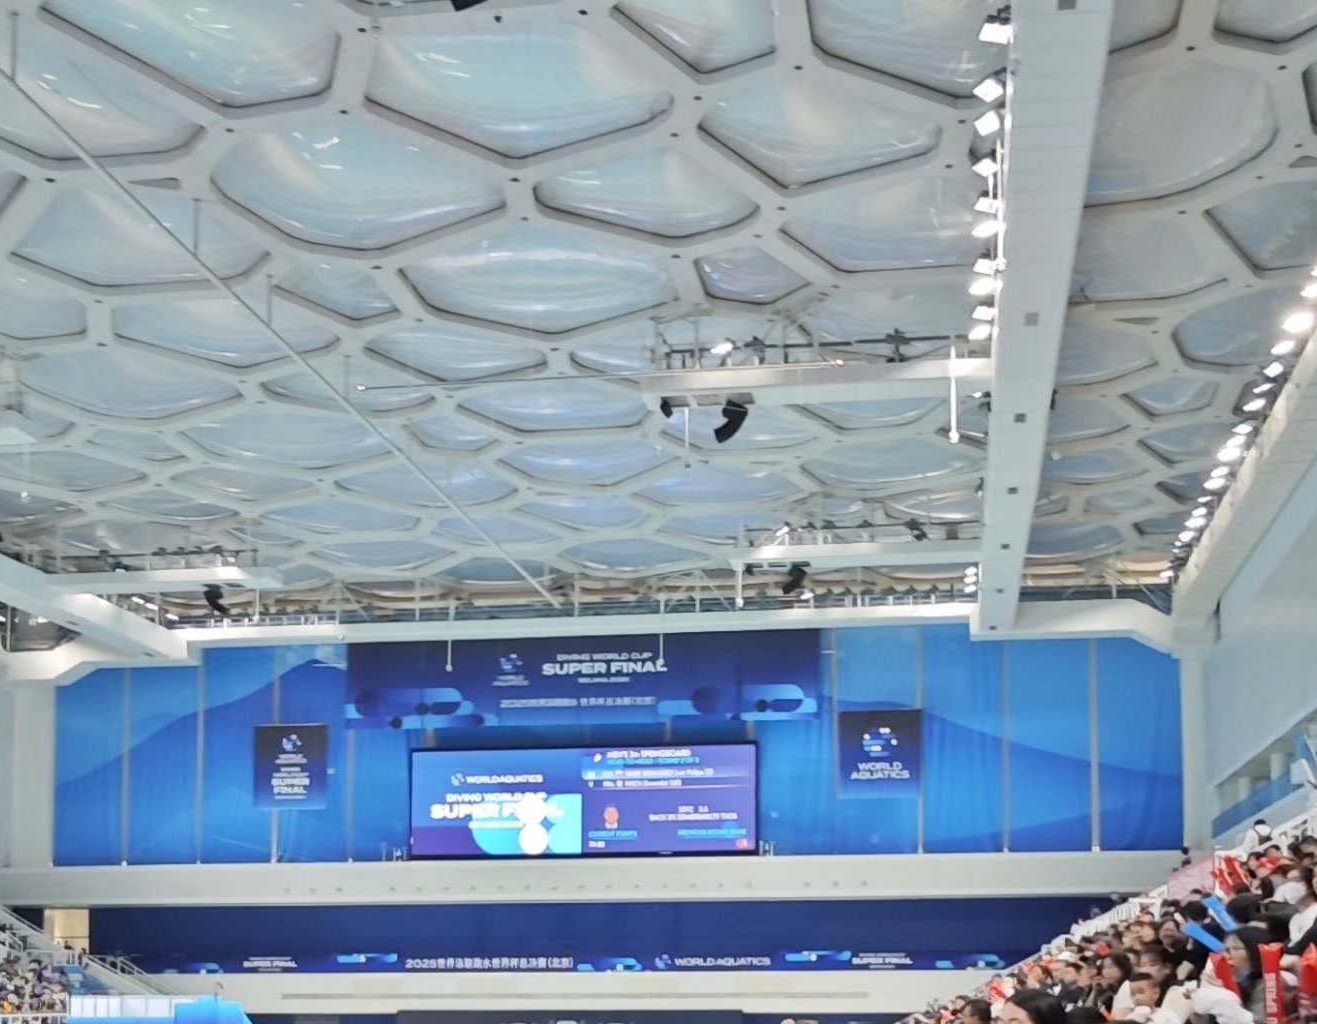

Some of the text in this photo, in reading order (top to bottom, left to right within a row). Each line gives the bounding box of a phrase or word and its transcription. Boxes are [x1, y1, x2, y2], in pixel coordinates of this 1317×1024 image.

[542, 660, 668, 675] SUPER FINAL
[857, 761, 903, 771] WORLD
[850, 769, 910, 779] AQUATICS
